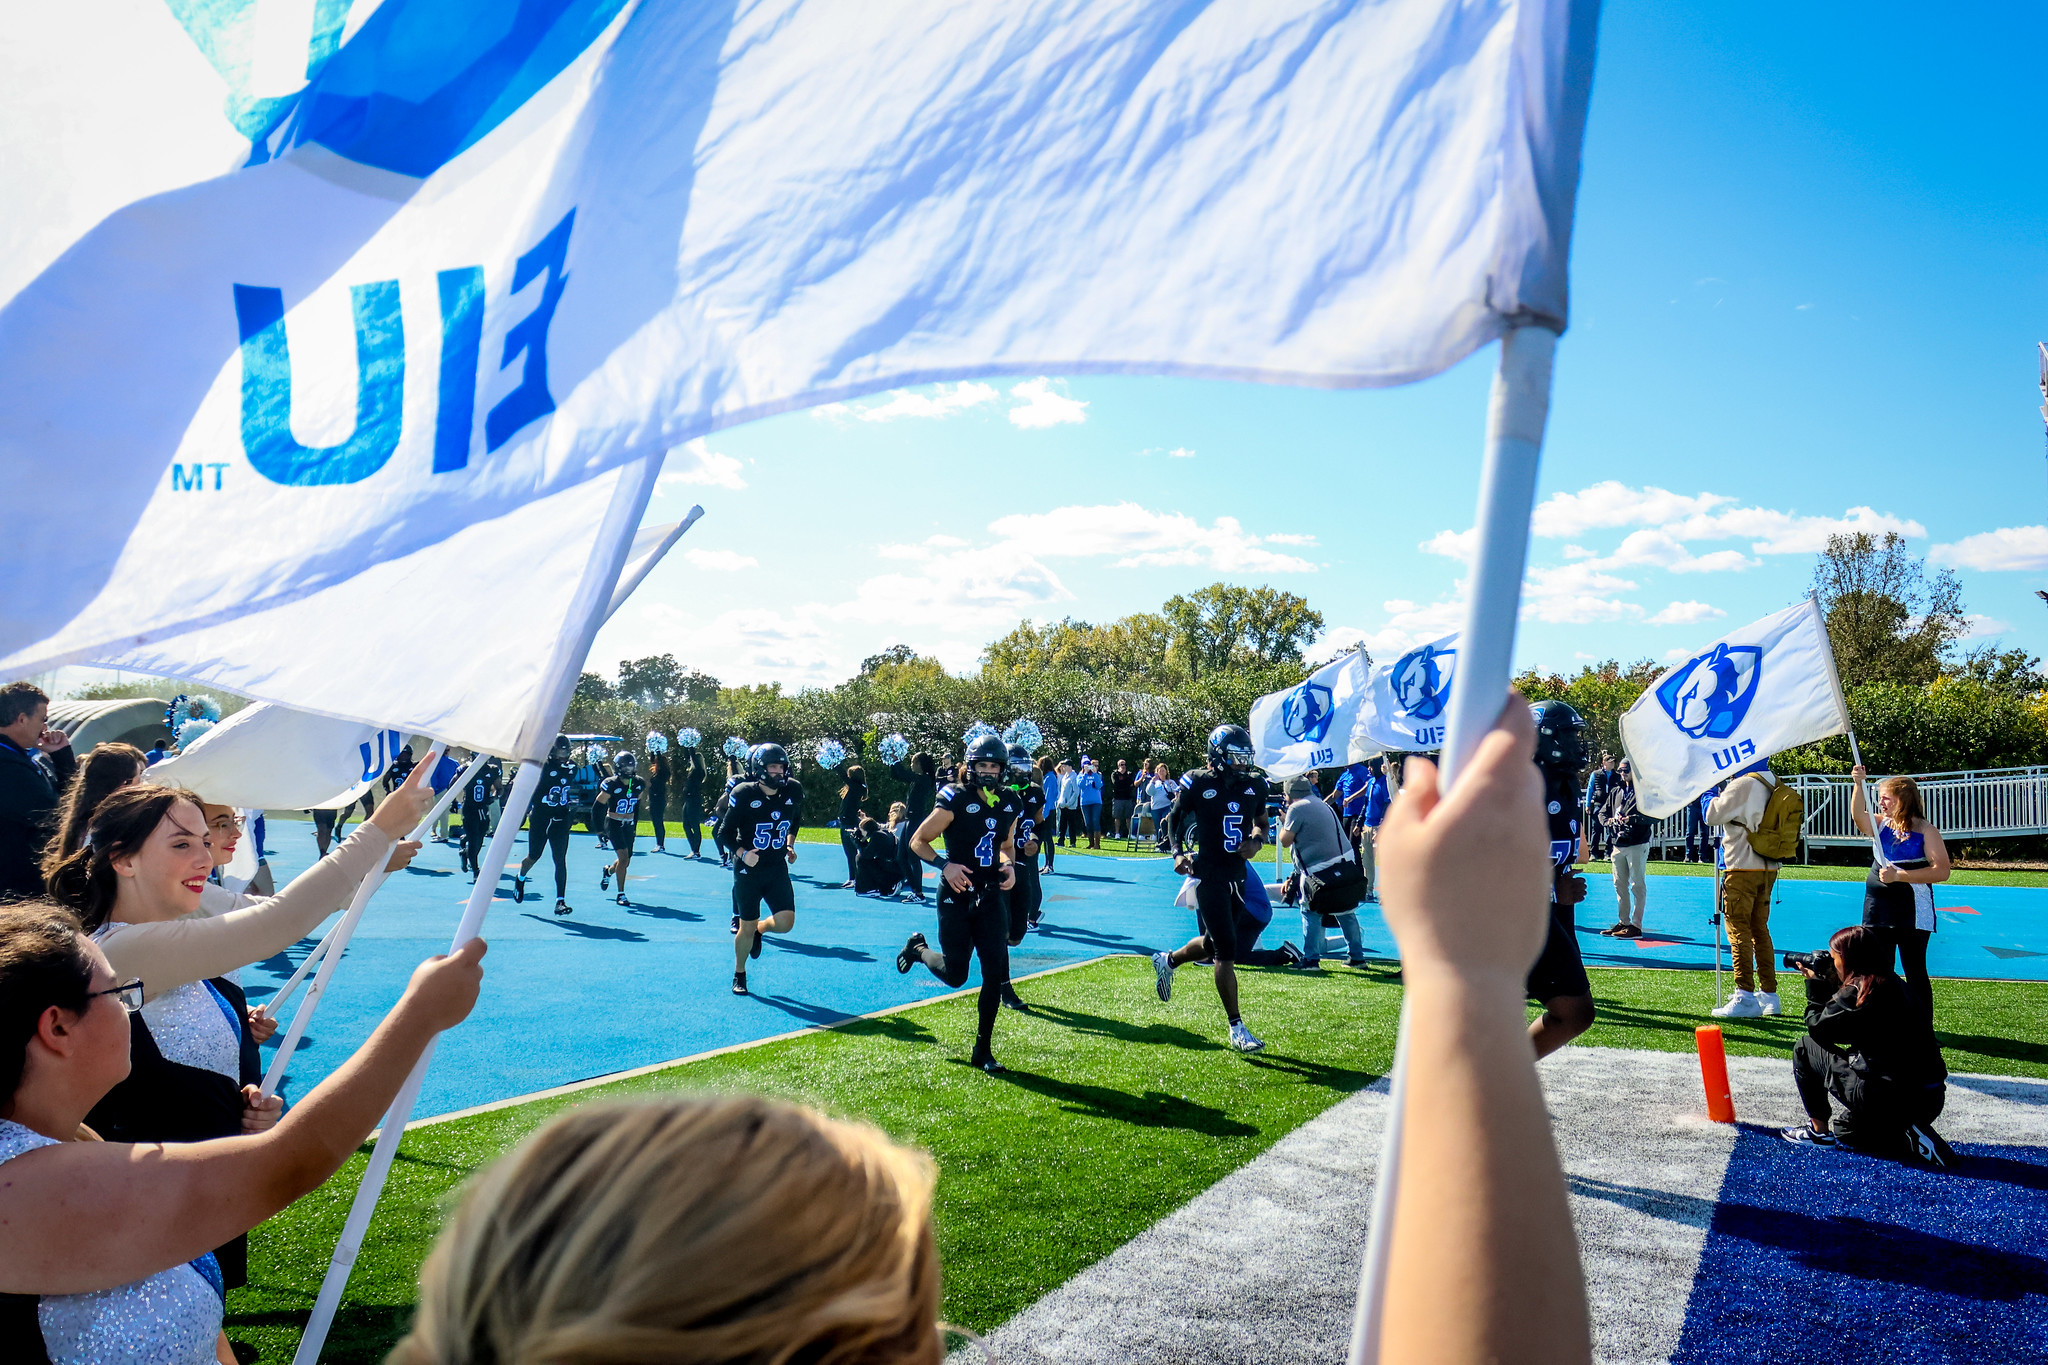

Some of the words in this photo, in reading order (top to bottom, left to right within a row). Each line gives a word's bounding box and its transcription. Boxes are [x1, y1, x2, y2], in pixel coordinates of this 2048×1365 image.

[473, 784, 485, 803] 8
[615, 797, 638, 815] 27
[752, 820, 791, 850] 53
[974, 831, 996, 867] 4
[1223, 815, 1244, 853] 5
